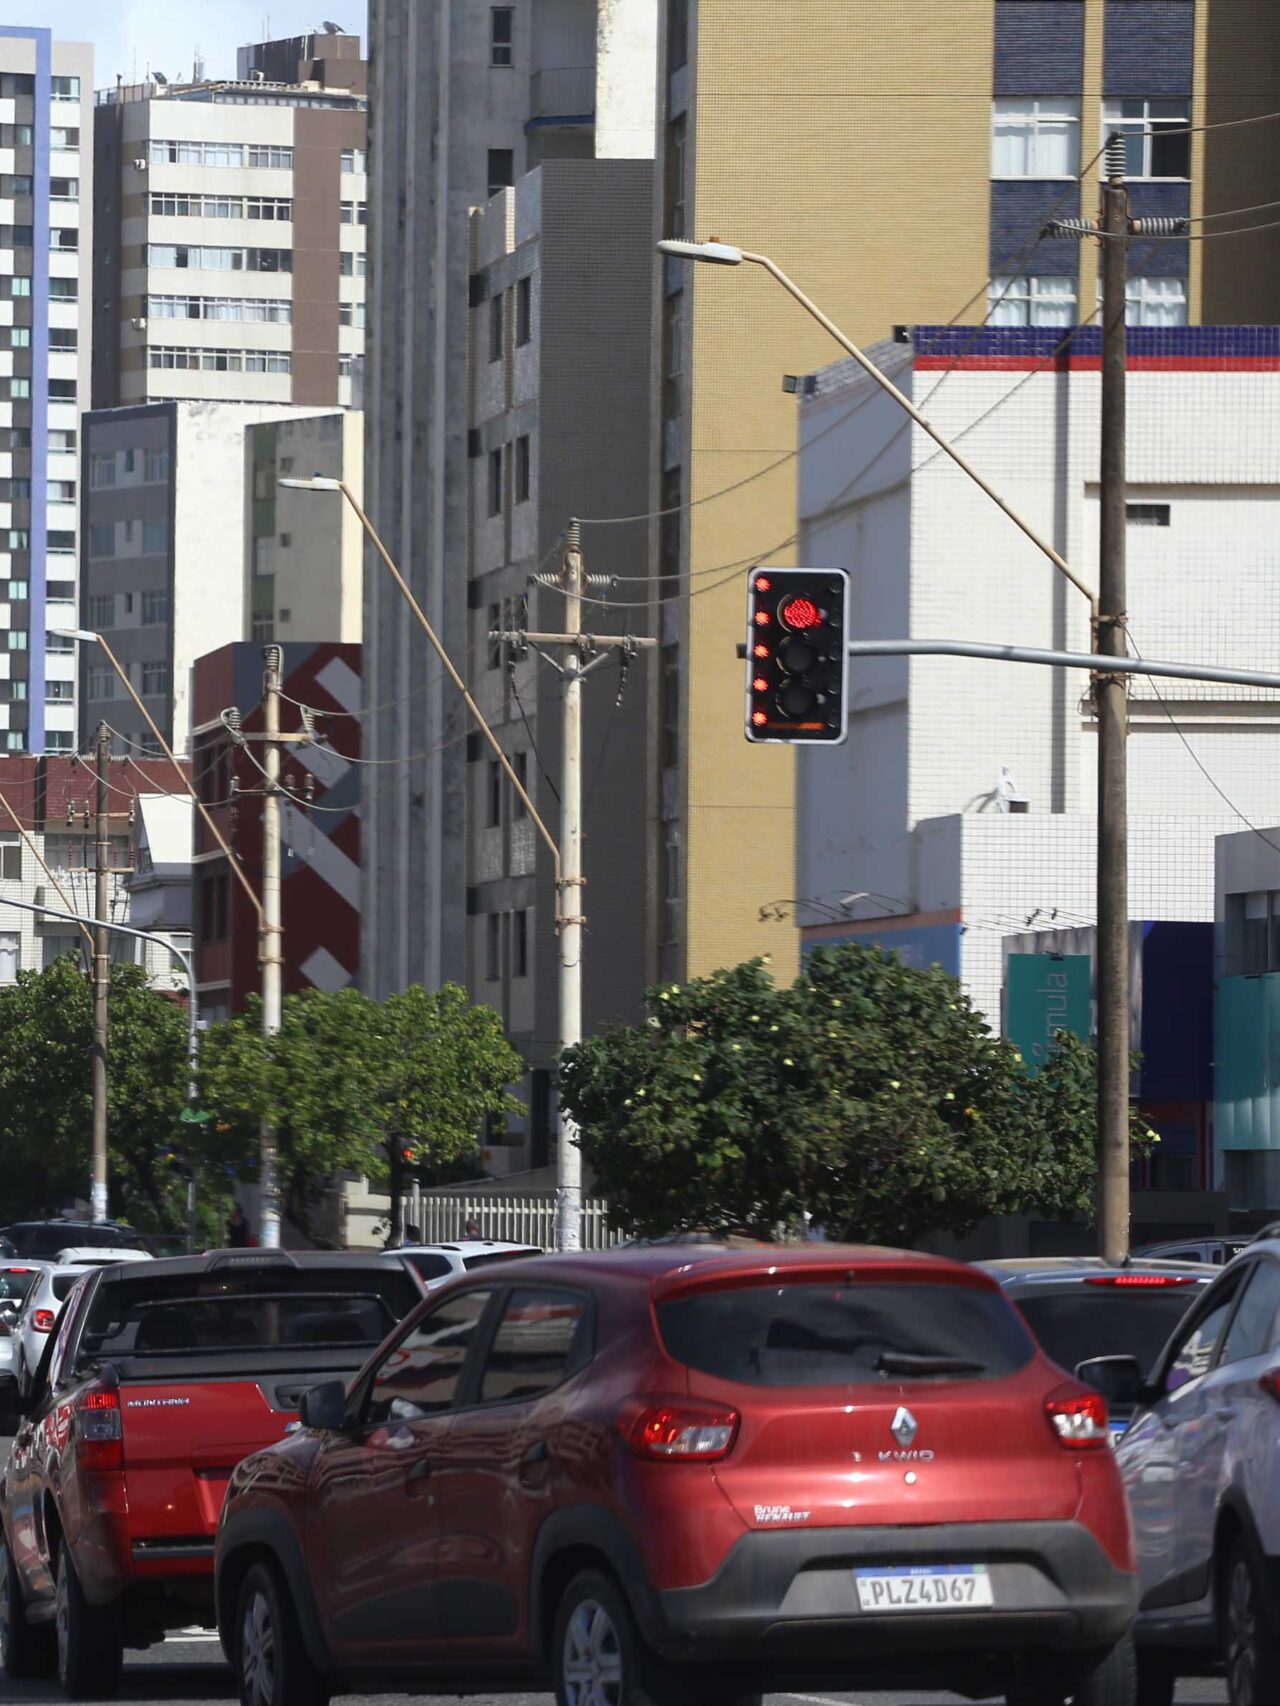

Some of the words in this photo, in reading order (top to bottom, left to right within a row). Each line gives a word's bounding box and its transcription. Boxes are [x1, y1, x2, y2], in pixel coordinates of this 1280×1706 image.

[1032, 971, 1068, 1065] mula
[878, 1449, 934, 1462] KWID
[870, 1577, 976, 1605] PLZ4D67
